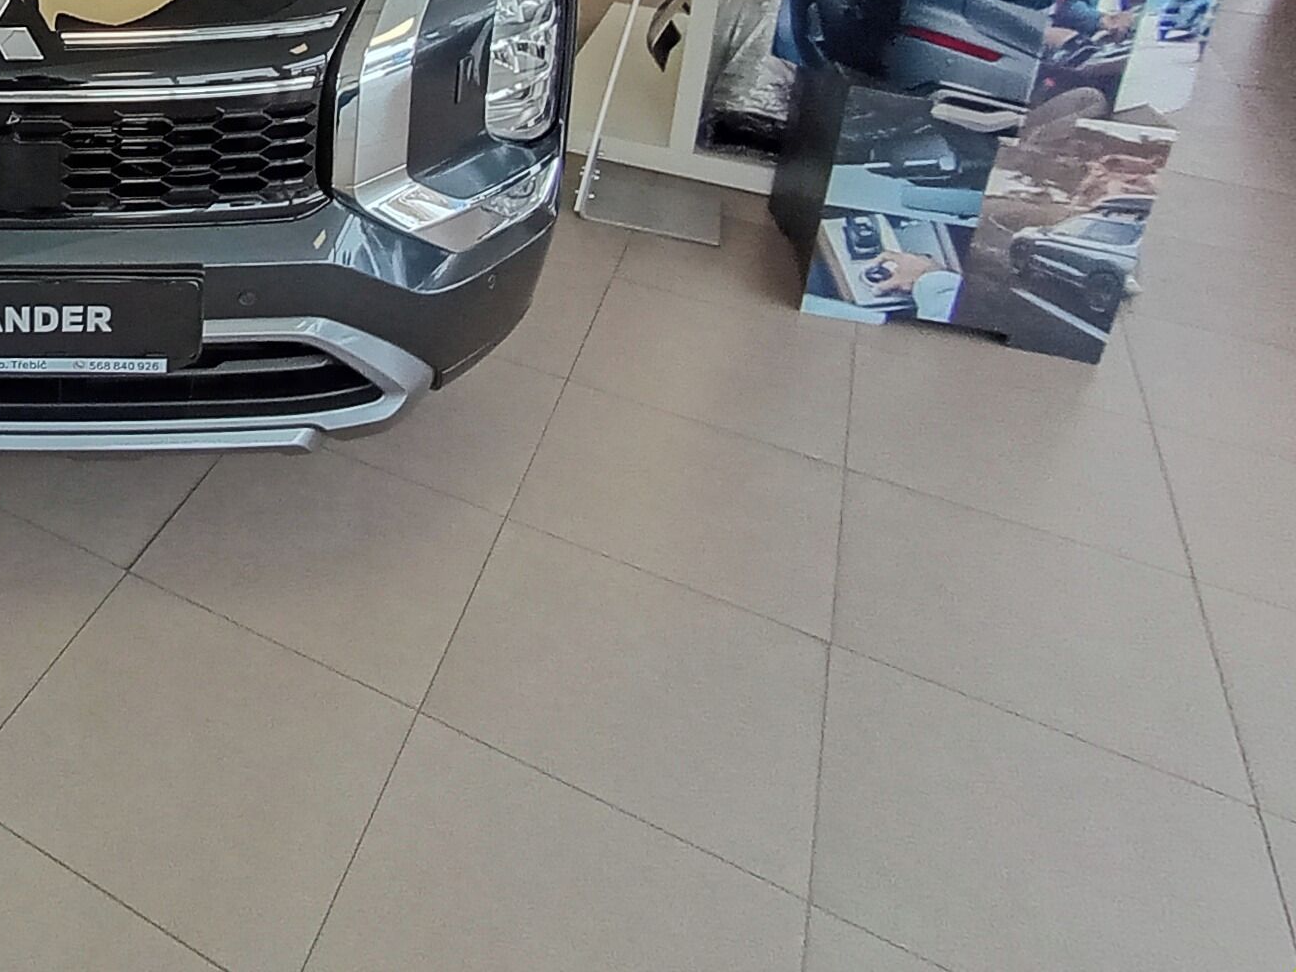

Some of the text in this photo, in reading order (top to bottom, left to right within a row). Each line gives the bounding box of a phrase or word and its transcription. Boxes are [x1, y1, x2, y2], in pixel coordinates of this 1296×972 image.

[11, 359, 48, 371] Třebíč
[88, 361, 111, 371] 568
[113, 361, 135, 372] 840
[137, 361, 160, 372] 926
